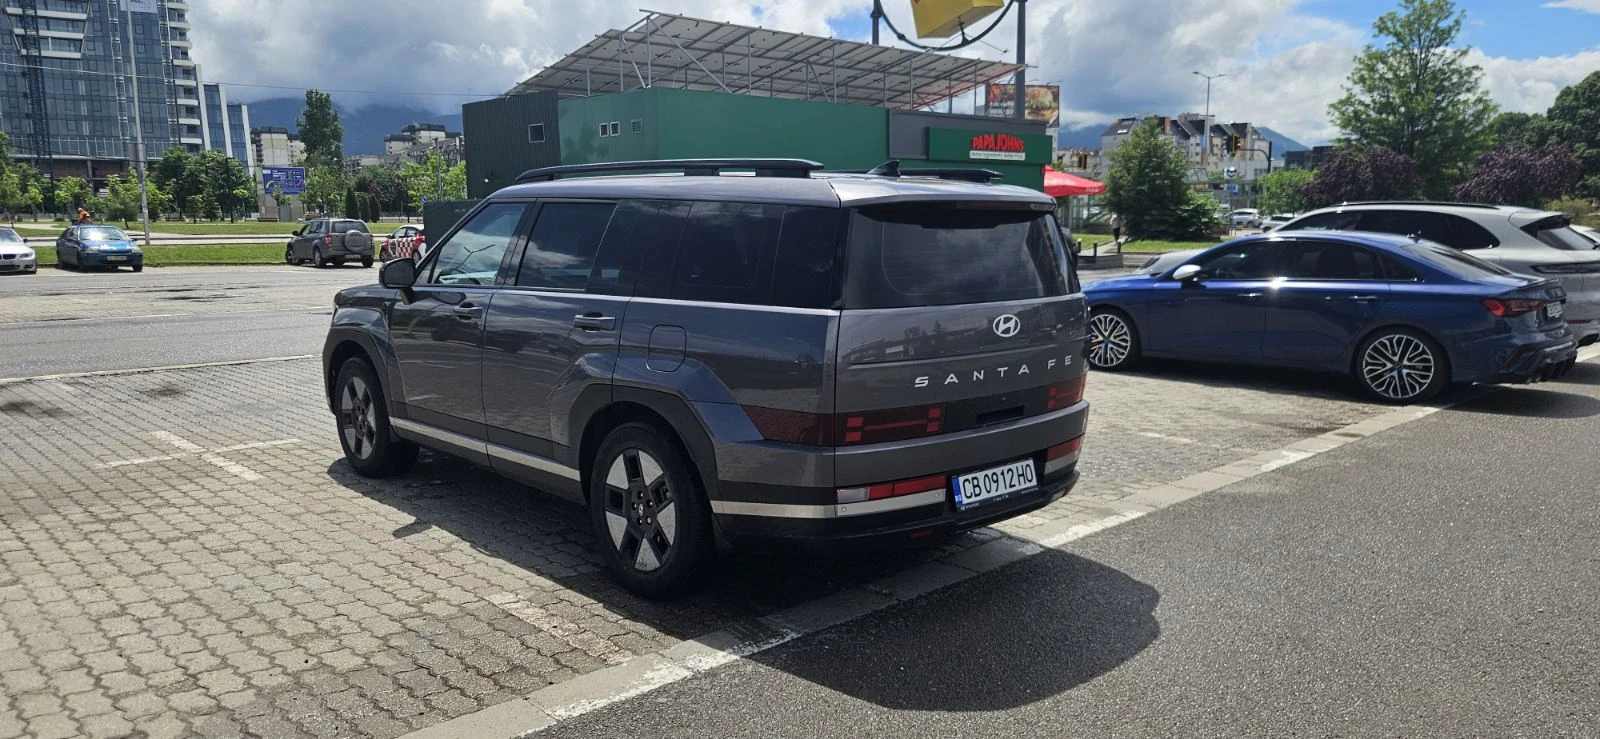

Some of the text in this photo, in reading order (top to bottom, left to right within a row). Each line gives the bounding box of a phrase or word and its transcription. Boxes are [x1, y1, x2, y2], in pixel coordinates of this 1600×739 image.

[971, 133, 1024, 152] PAPA JOHNS
[914, 355, 1072, 388] SANTA FE
[962, 476, 982, 499] CB
[983, 468, 1016, 494] 0912
